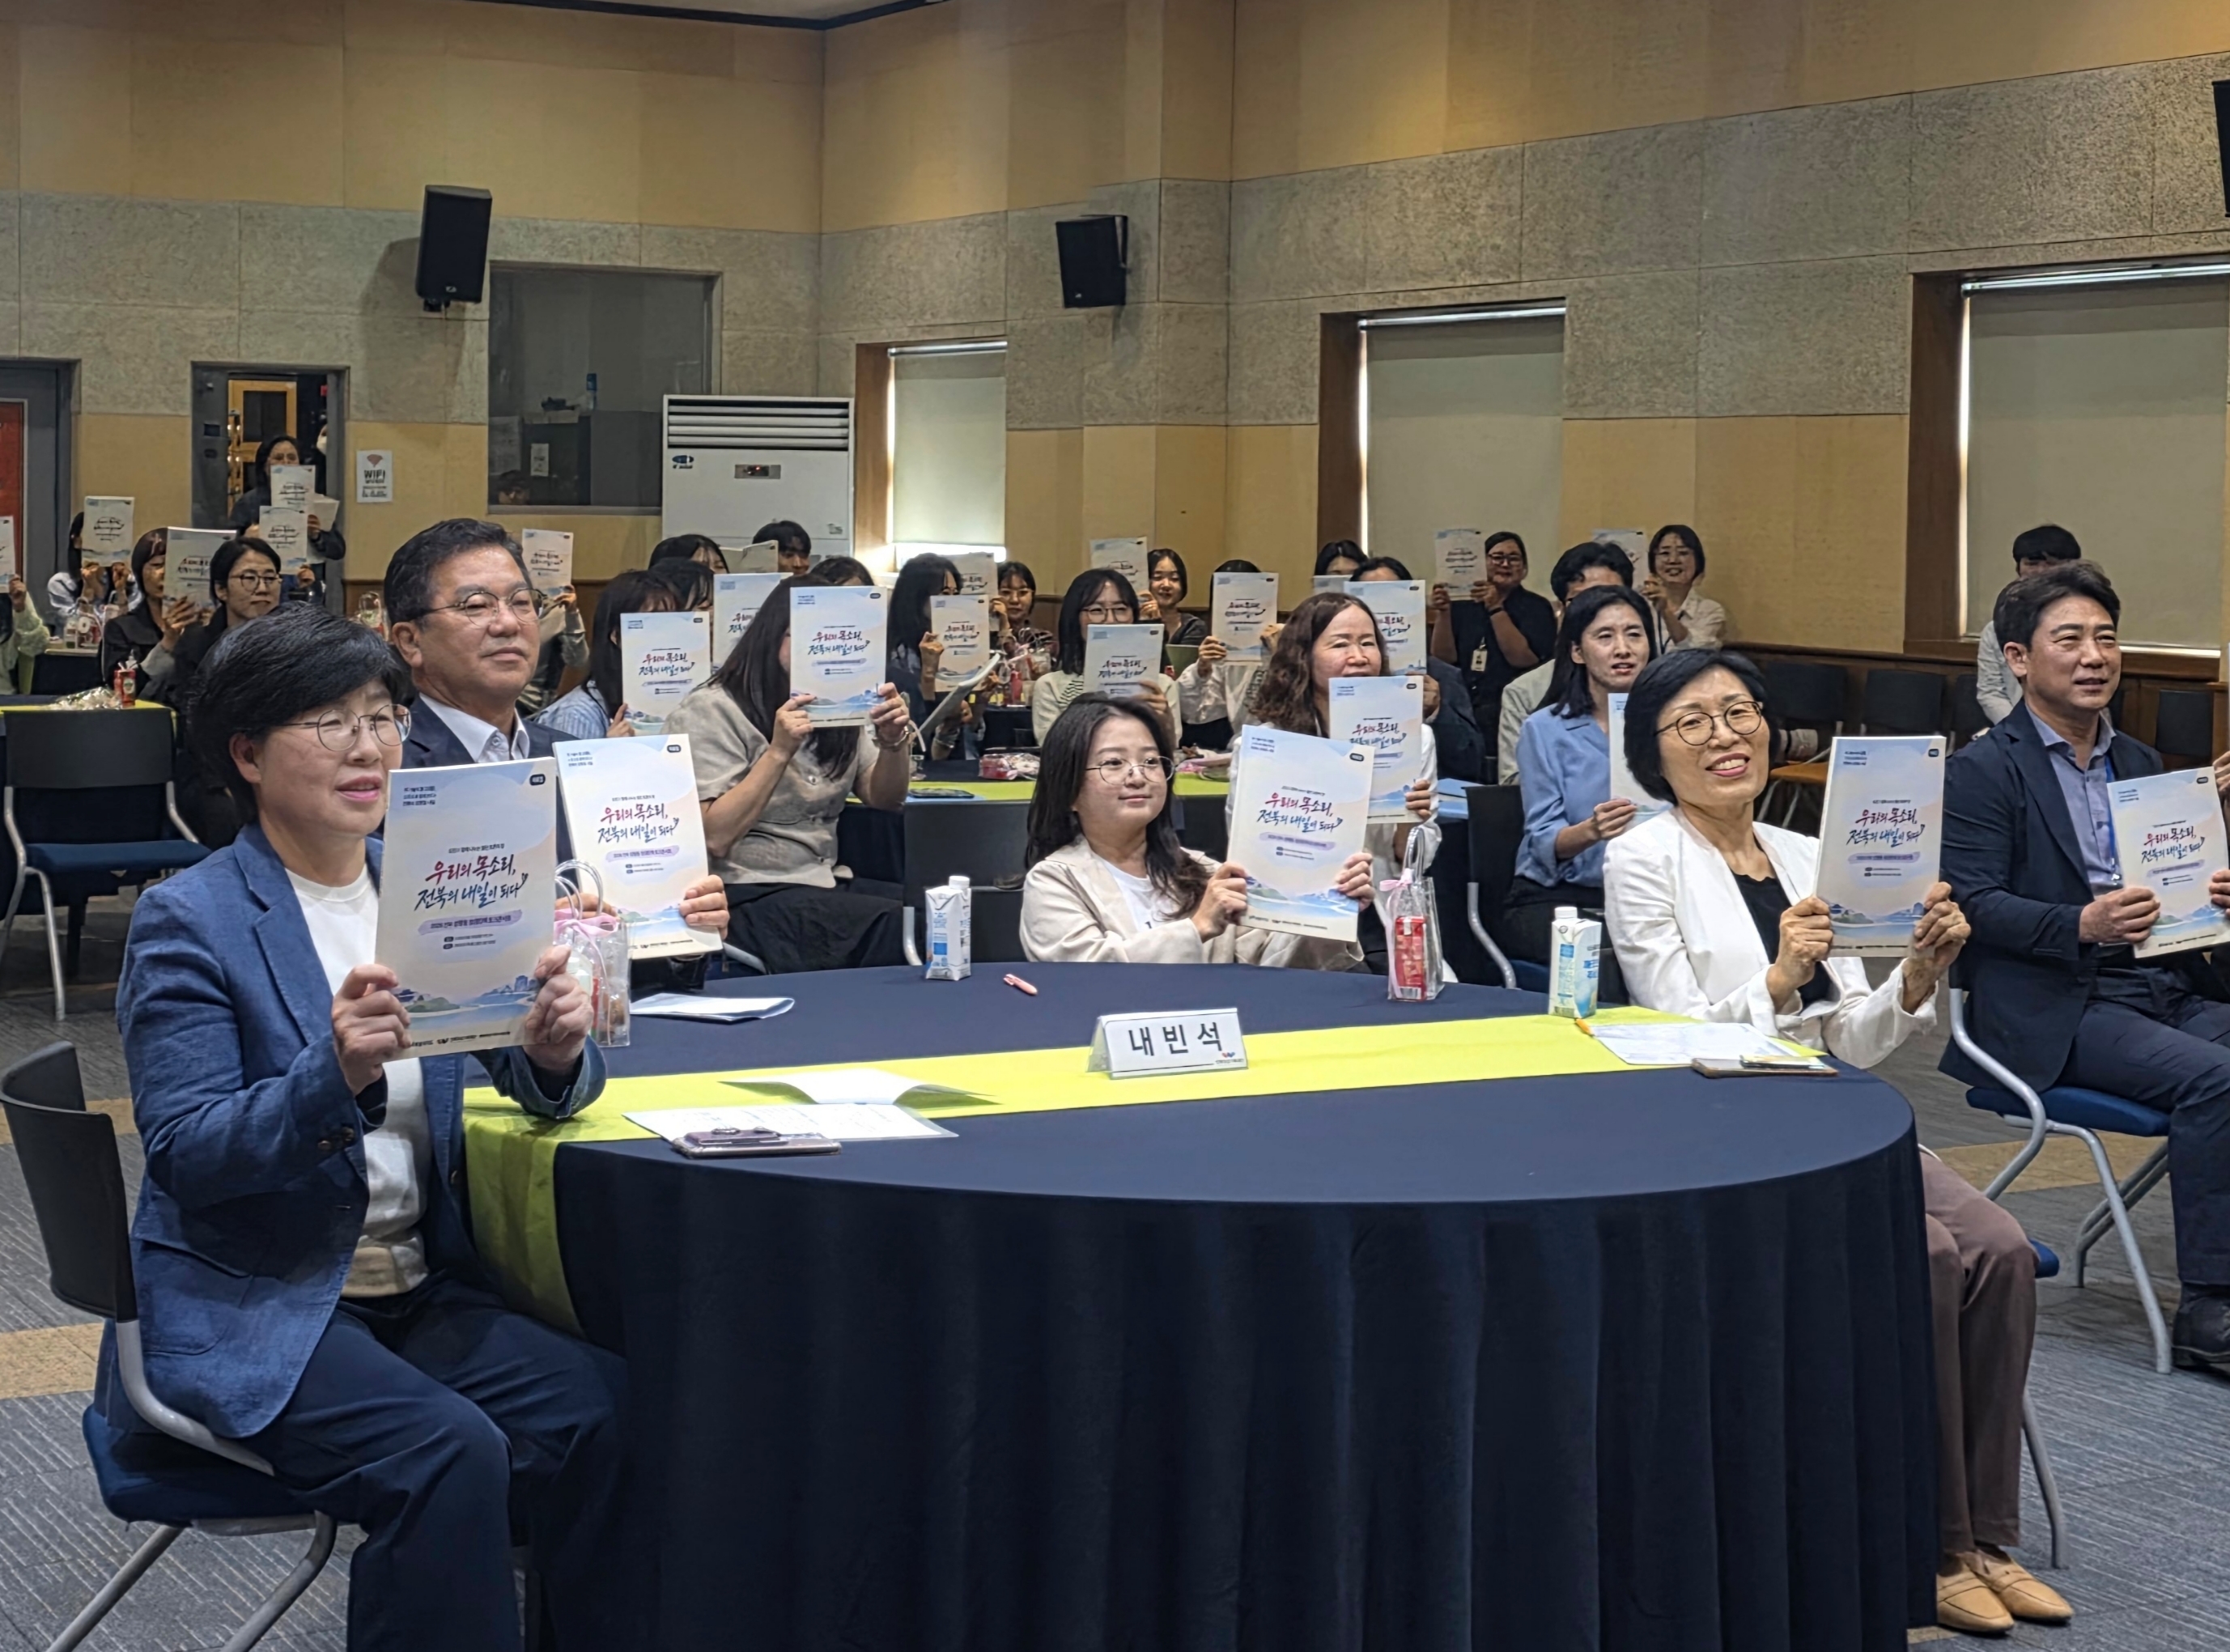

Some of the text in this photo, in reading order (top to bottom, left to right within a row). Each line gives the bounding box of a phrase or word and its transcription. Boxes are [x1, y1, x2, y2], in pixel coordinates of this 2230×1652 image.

[601, 807, 632, 824] 우리의
[425, 854, 516, 885] 우리의 목소리,
[414, 885, 459, 911] 전북의
[461, 881, 498, 908] 내일이
[1128, 1021, 1222, 1055] 내빈석
